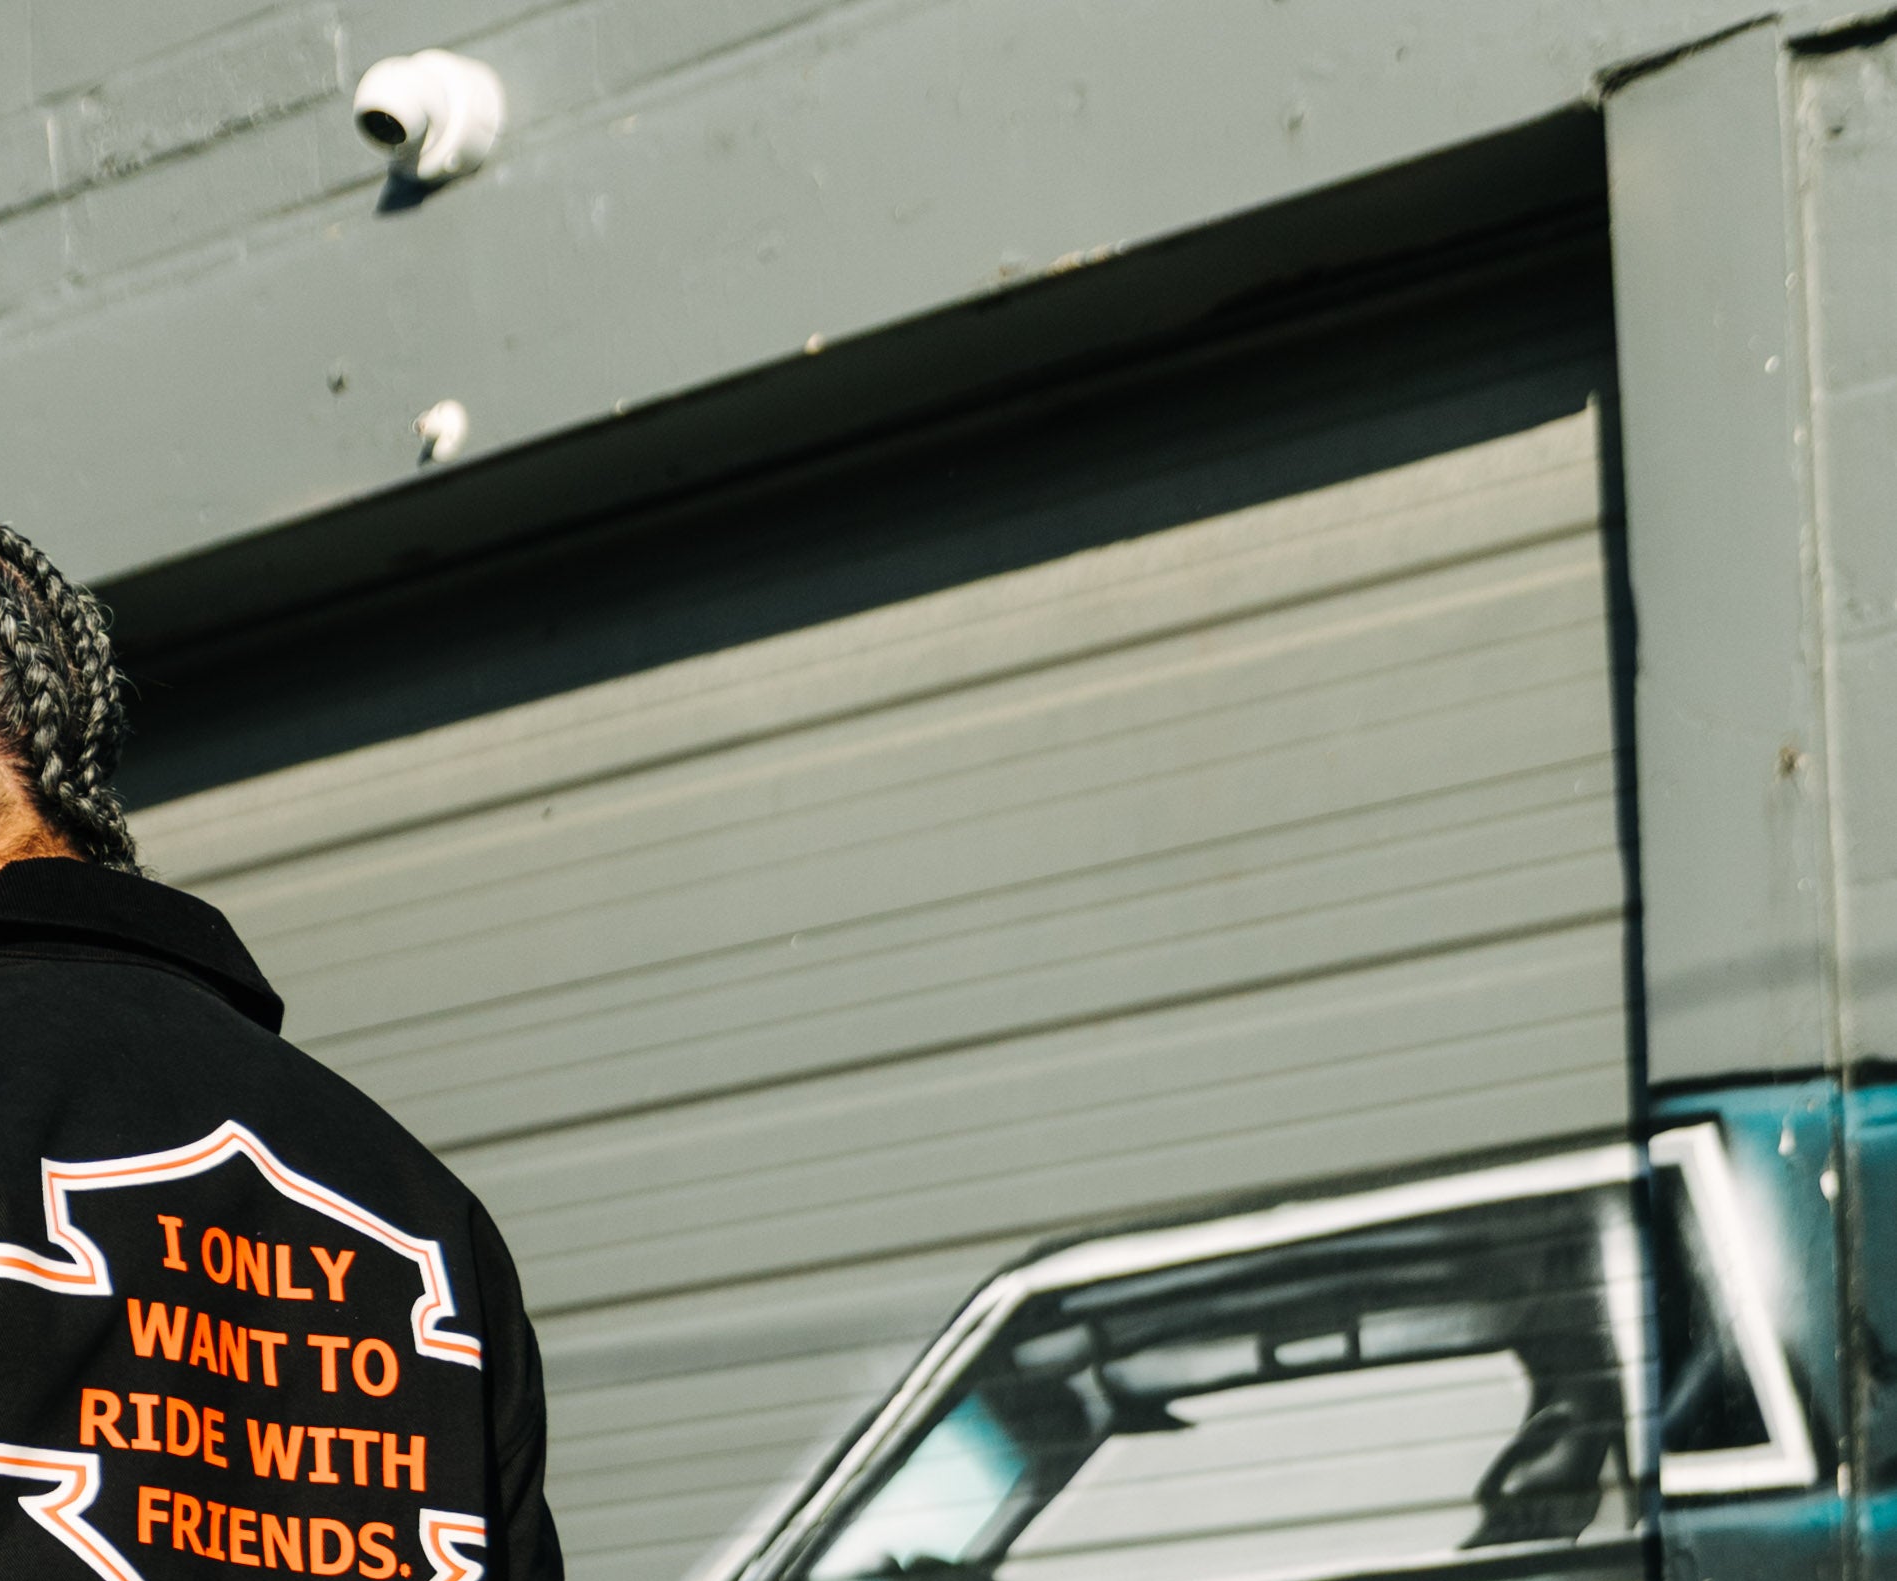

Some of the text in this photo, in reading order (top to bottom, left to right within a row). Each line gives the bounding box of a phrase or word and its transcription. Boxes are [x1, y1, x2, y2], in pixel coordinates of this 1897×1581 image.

[157, 1214, 357, 1303] I ONLY
[126, 1297, 400, 1398] WANT TO
[79, 1387, 427, 1492] RIDE WITH
[137, 1485, 412, 1580] FRIENDS.
